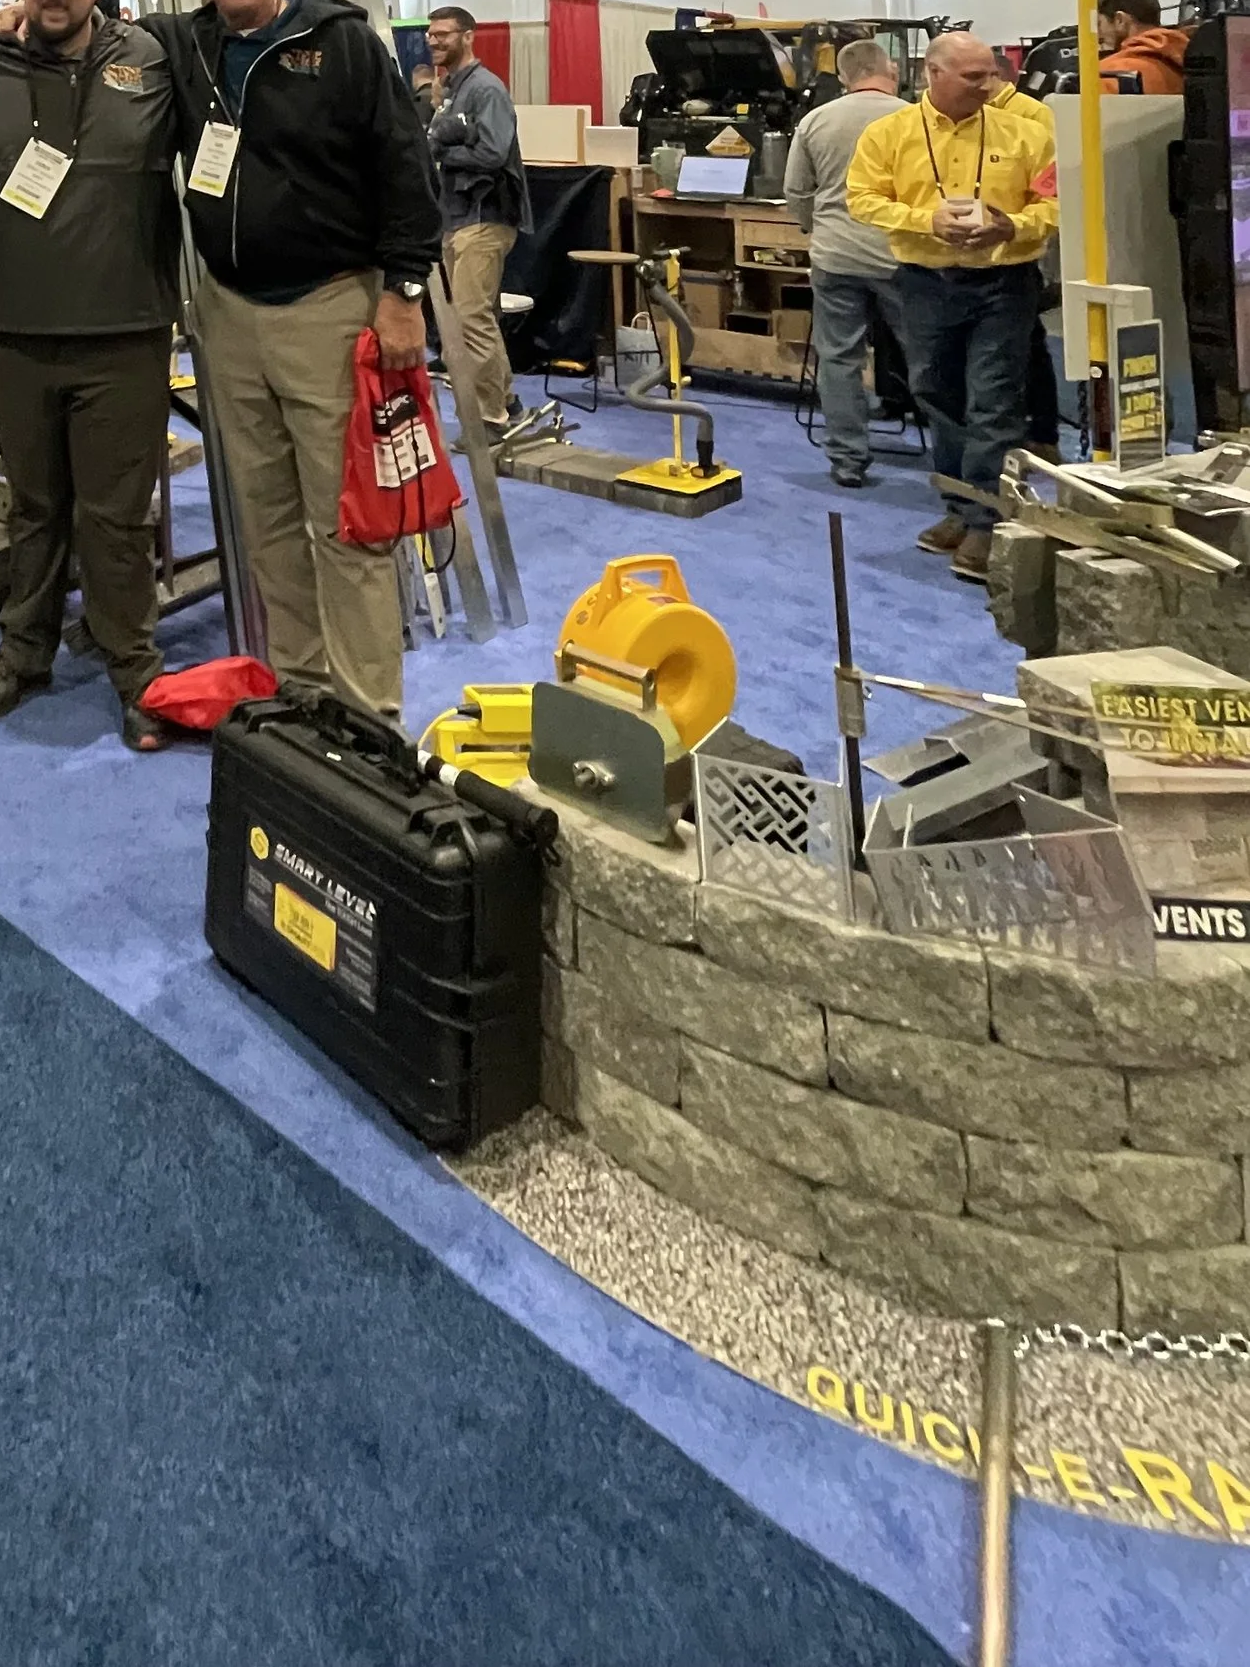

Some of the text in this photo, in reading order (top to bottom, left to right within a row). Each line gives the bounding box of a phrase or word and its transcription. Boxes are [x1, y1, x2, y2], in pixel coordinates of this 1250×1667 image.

[1101, 694, 1197, 720] EASIEST
[1119, 727, 1155, 751] TO
[275, 844, 324, 885] SMART
[1153, 905, 1246, 938] VENTS
